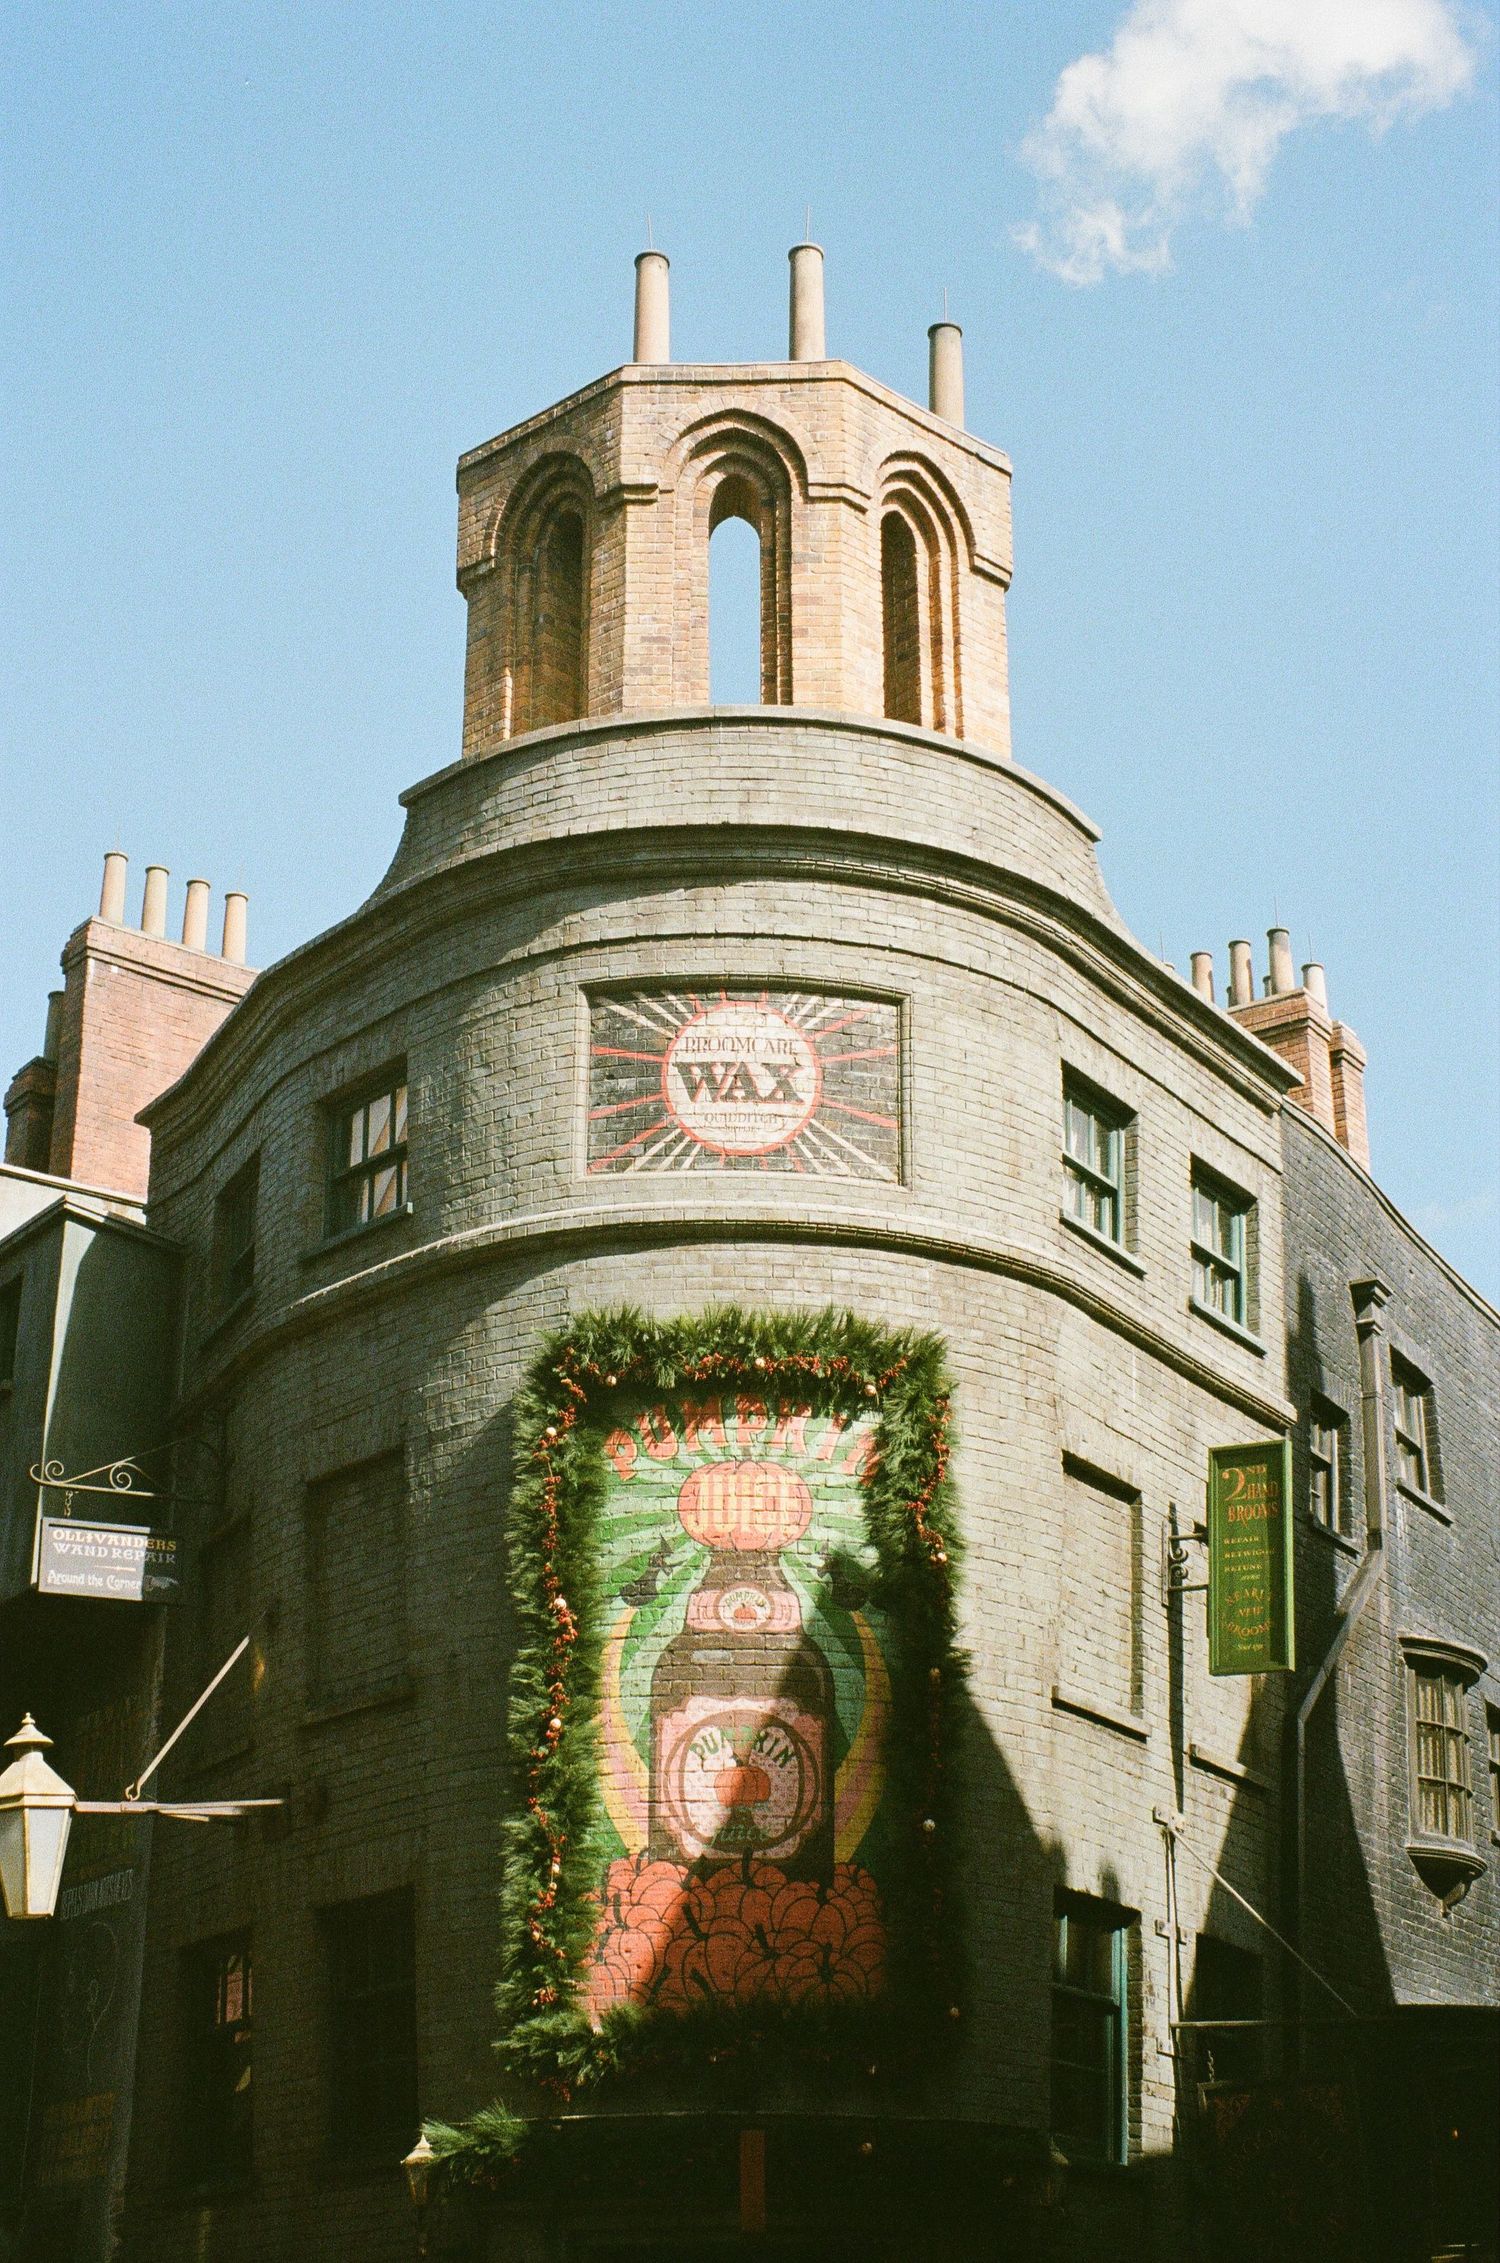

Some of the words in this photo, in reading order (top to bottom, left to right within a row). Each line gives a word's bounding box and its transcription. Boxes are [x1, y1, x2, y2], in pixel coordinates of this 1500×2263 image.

[685, 1036, 796, 1055] BROOMCARE
[672, 1061, 805, 1104] WAX
[703, 1112, 778, 1125] QUIDDITCH
[686, 1474, 801, 1533] JUICE
[1228, 1502, 1280, 1529] BROOMS
[53, 1529, 177, 1551] OLLIVANDERS
[53, 1542, 108, 1558] WAND
[111, 1548, 176, 1564] REPAIR
[47, 1570, 86, 1586] Around
[88, 1572, 104, 1587] the
[106, 1574, 143, 1591] Corner
[688, 1725, 795, 1769] PUMPKIN
